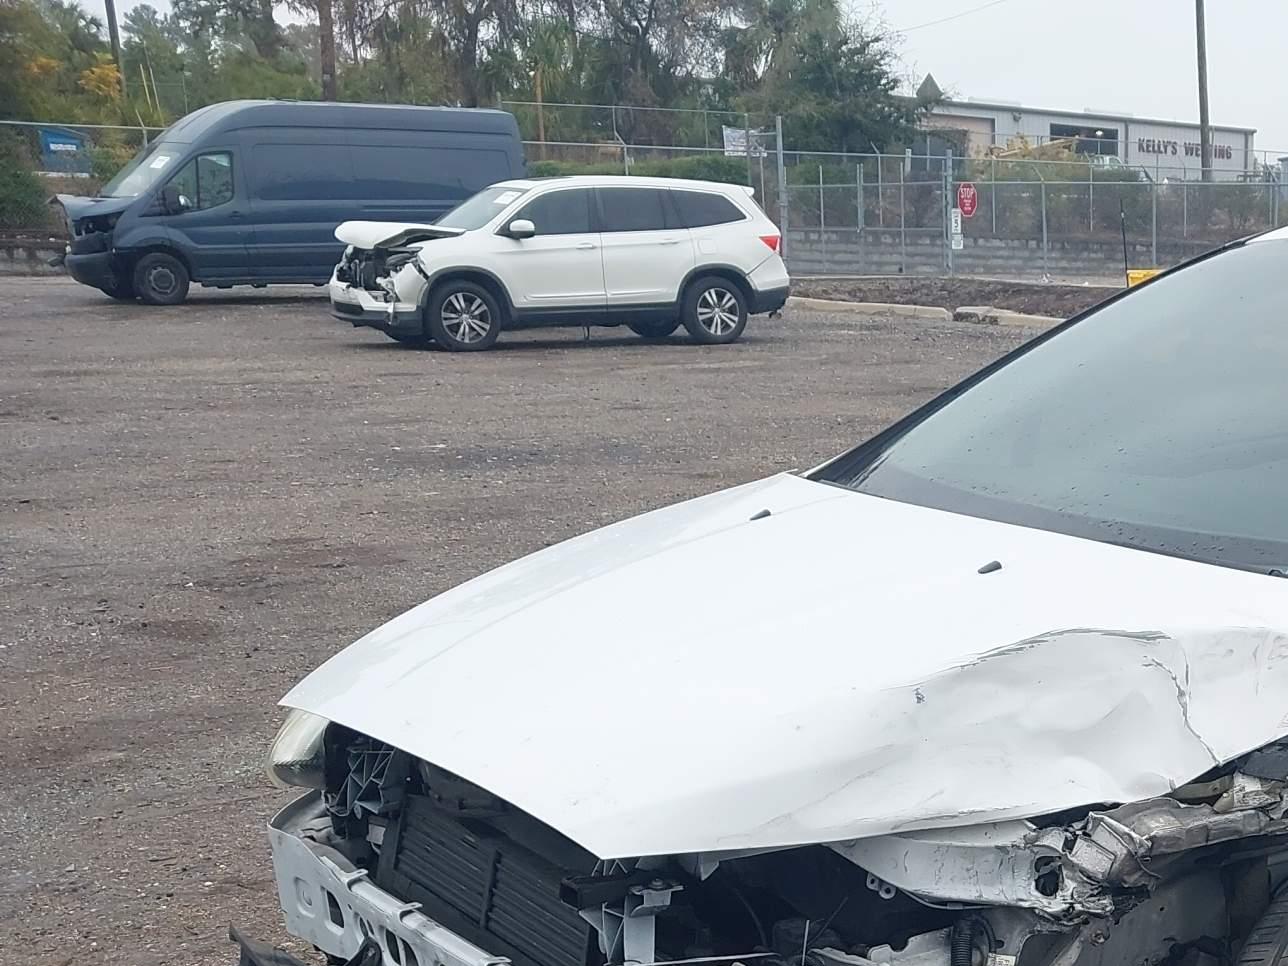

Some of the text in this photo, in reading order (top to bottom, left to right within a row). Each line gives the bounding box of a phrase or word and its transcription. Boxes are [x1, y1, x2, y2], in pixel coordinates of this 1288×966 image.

[1138, 138, 1232, 160] KELLY'S WEING
[960, 187, 974, 199] STOP
